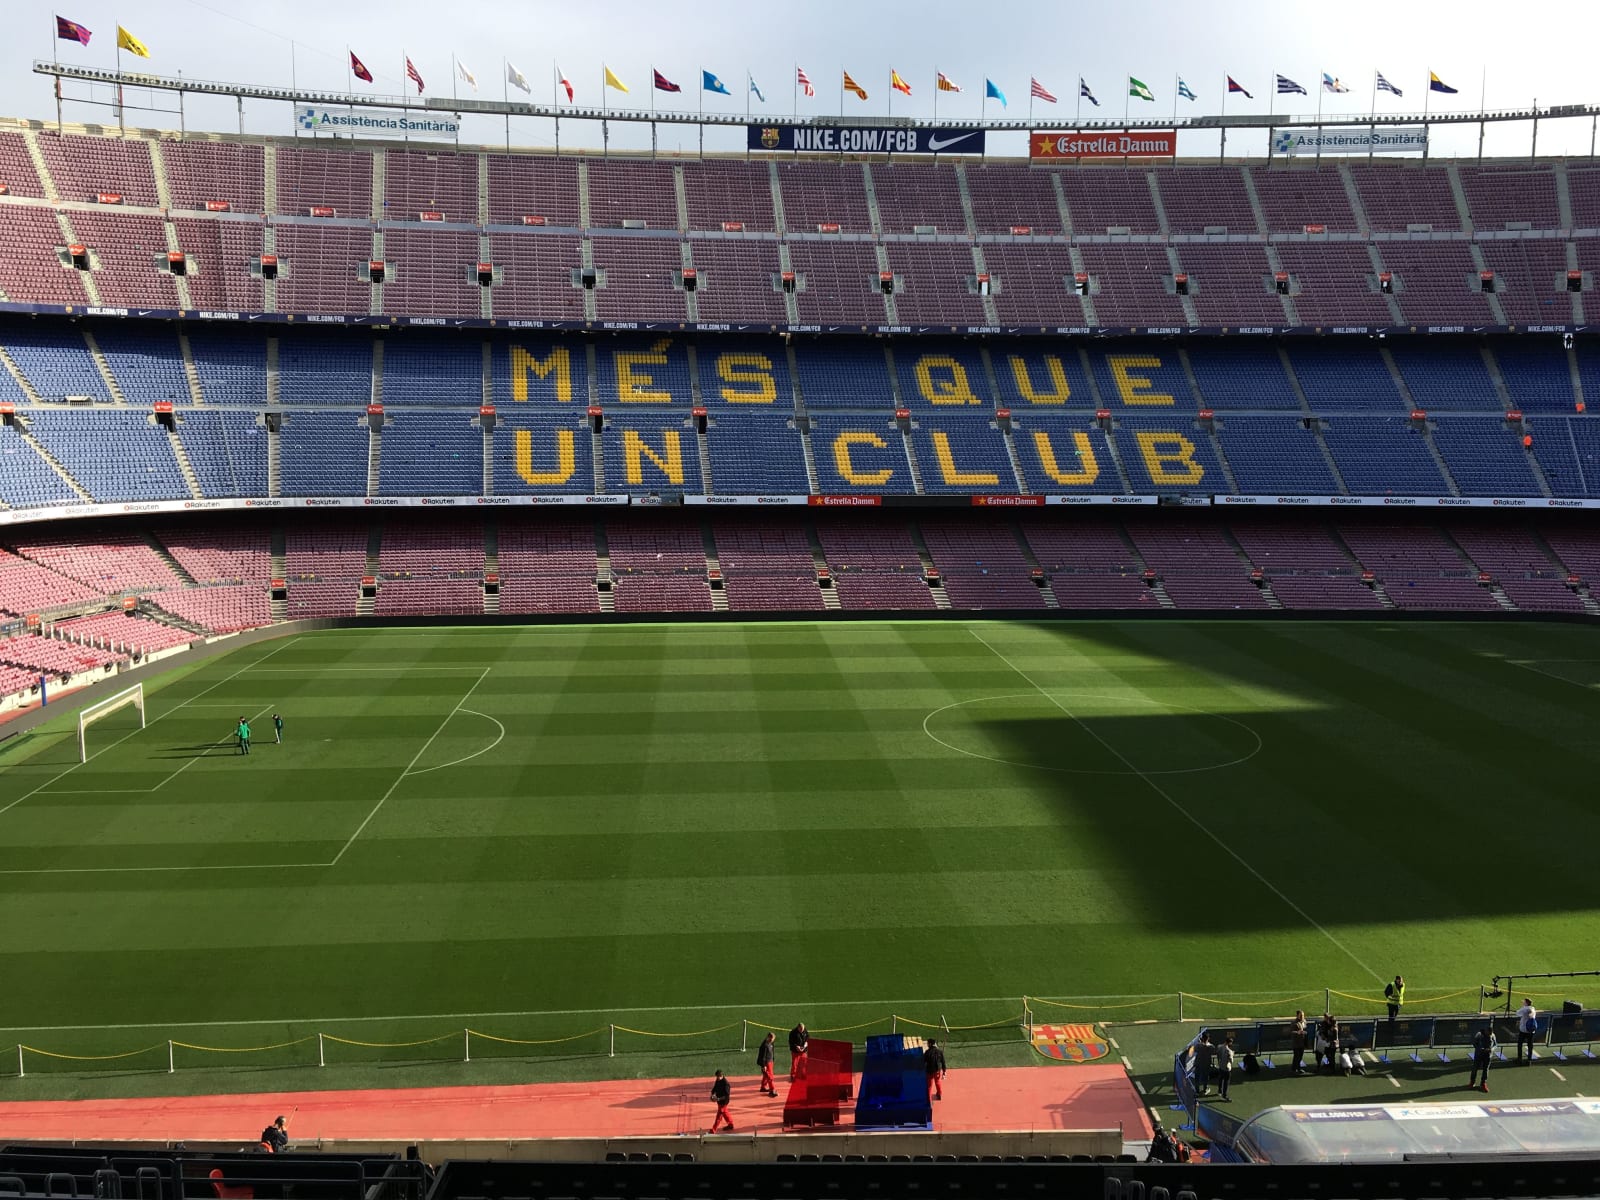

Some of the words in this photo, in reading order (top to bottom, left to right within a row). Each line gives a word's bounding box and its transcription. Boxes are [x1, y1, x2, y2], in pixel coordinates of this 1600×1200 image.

[321, 112, 397, 129] Assistència
[399, 118, 456, 132] Sanitària
[793, 128, 917, 151] NIKE.COM/FCB
[1296, 133, 1370, 146] Assistència
[1371, 133, 1428, 145] Sanitària
[1057, 136, 1117, 153] Estrella
[1118, 136, 1169, 153] Damm
[511, 339, 778, 404] MÉS
[914, 354, 1175, 406] QUE
[514, 429, 685, 485] UN
[832, 430, 1205, 485] CLUB
[251, 499, 281, 507] Rakuten
[312, 498, 340, 506] Rakuten
[427, 497, 455, 505] Rakuten
[824, 496, 852, 505] Estrella
[852, 497, 875, 505] Damm
[987, 496, 1014, 505] Estrella
[1014, 497, 1037, 505] Damm
[1066, 496, 1091, 504] Rakuten
[1117, 496, 1142, 504] Rakuten
[1231, 496, 1256, 504] Rakuten
[1335, 497, 1362, 505] Rakuten
[1390, 497, 1416, 505] Rakuten
[1498, 498, 1526, 506] Rakuten
[1554, 499, 1582, 507] Rakuten
[130, 503, 159, 512] Rakuten
[190, 501, 220, 509] Rakuten
